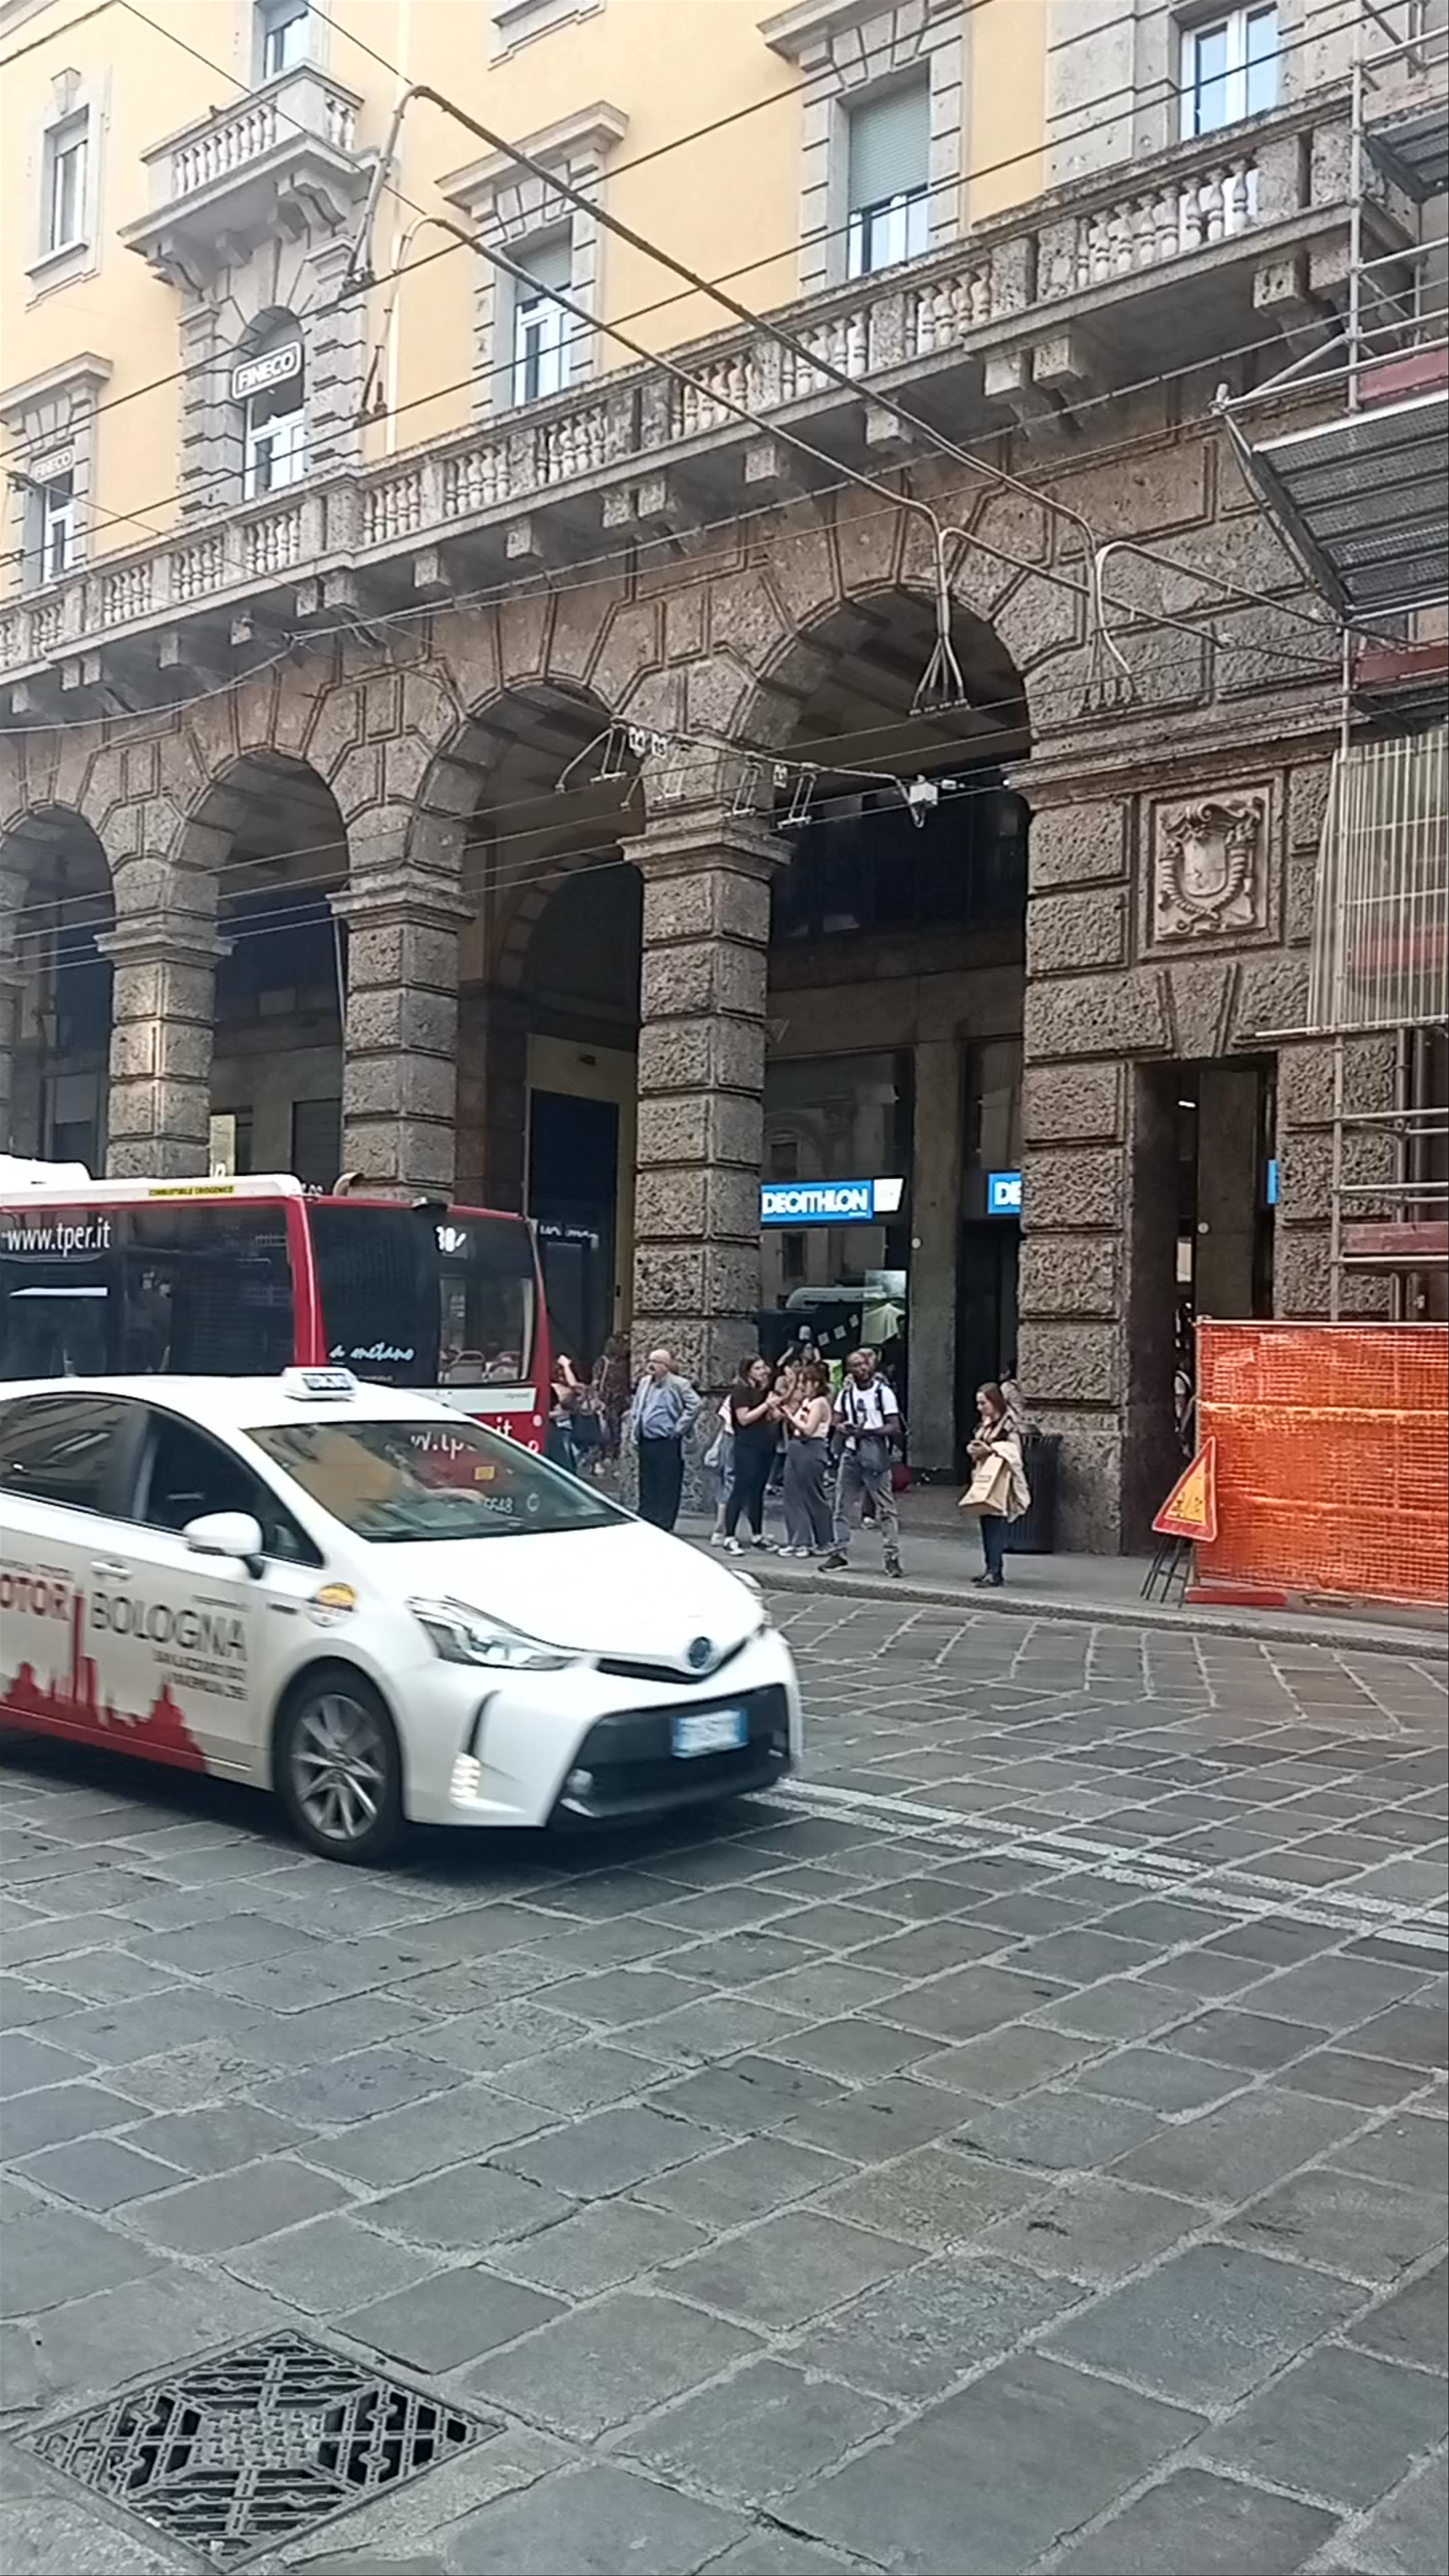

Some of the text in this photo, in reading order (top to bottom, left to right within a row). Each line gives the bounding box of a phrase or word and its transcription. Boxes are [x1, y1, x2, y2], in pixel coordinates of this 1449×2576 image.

[238, 351, 294, 390] FINECO
[762, 1188, 868, 1214] DECATHLON
[7, 1217, 111, 1258] www.tper.it
[90, 1591, 248, 1661] BOLOGNA
